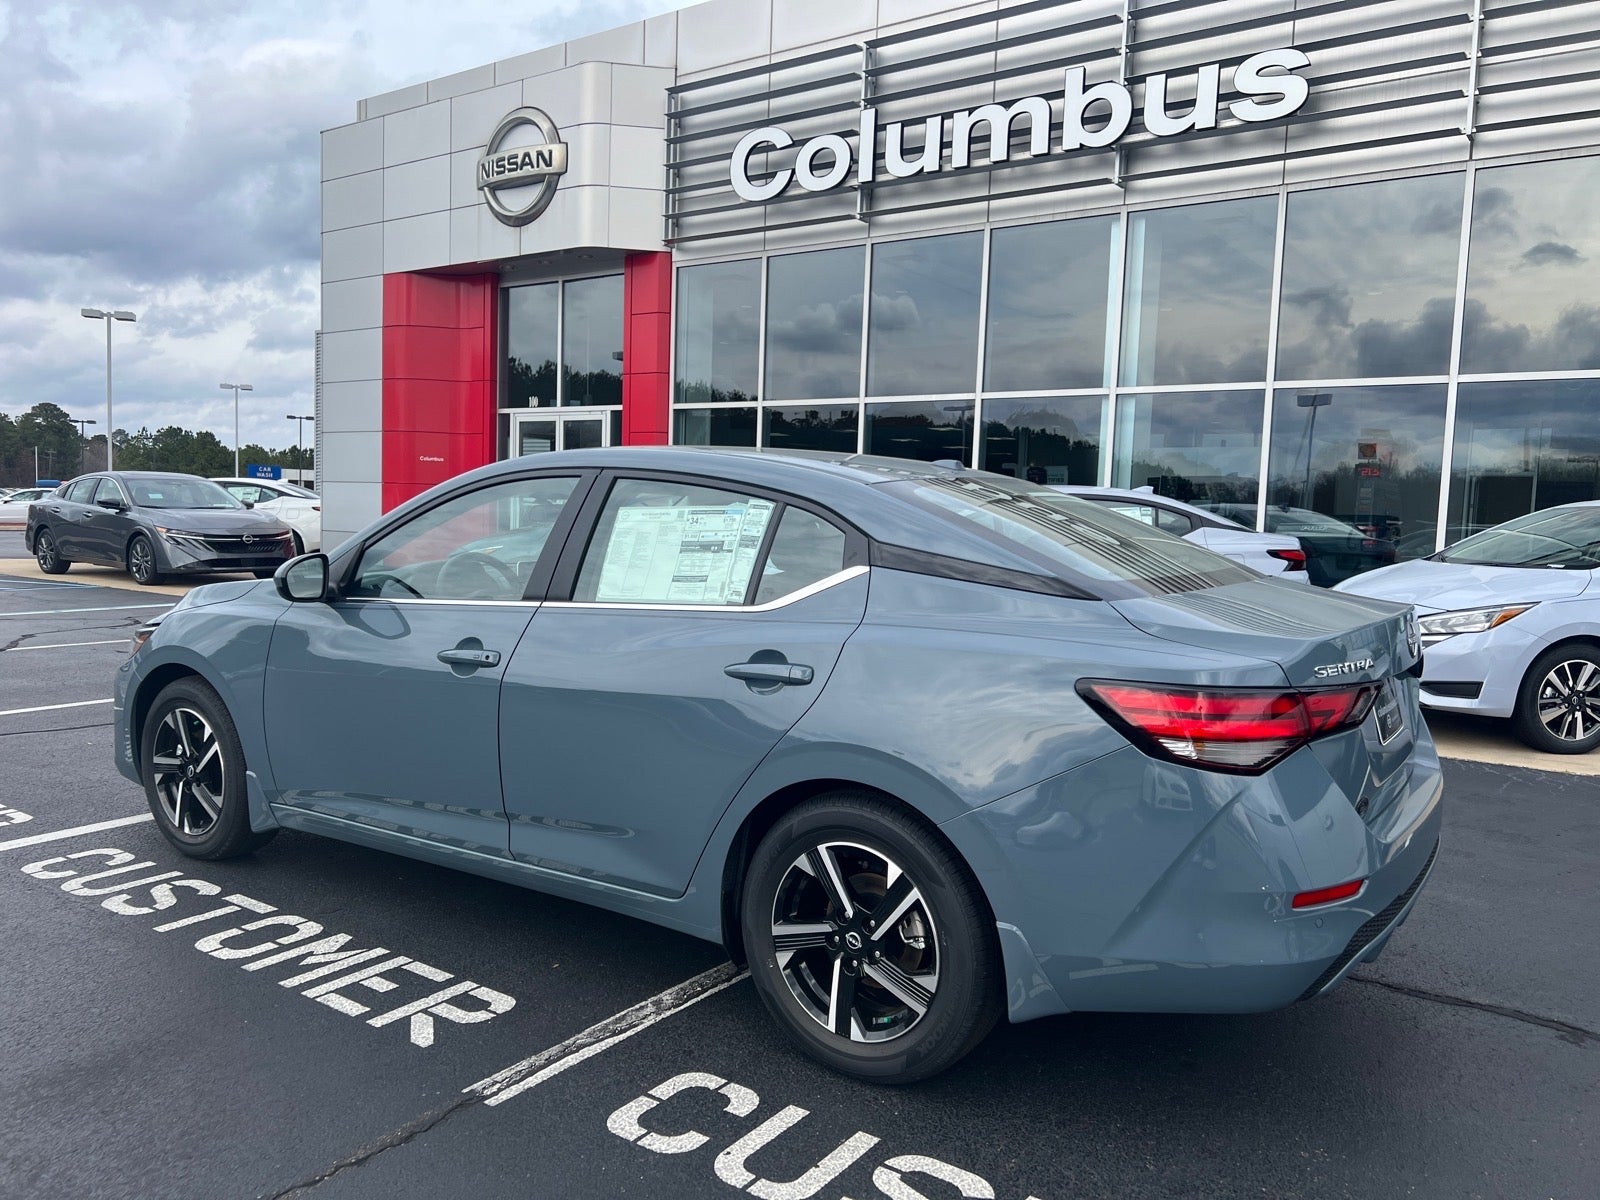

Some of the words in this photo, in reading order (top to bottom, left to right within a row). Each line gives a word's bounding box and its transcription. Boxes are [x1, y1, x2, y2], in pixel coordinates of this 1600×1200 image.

[480, 148, 553, 181] NISSAN
[729, 48, 1311, 201] Columbus
[1314, 658, 1375, 678] SENTRA
[20, 848, 517, 1048] CUSTOMER
